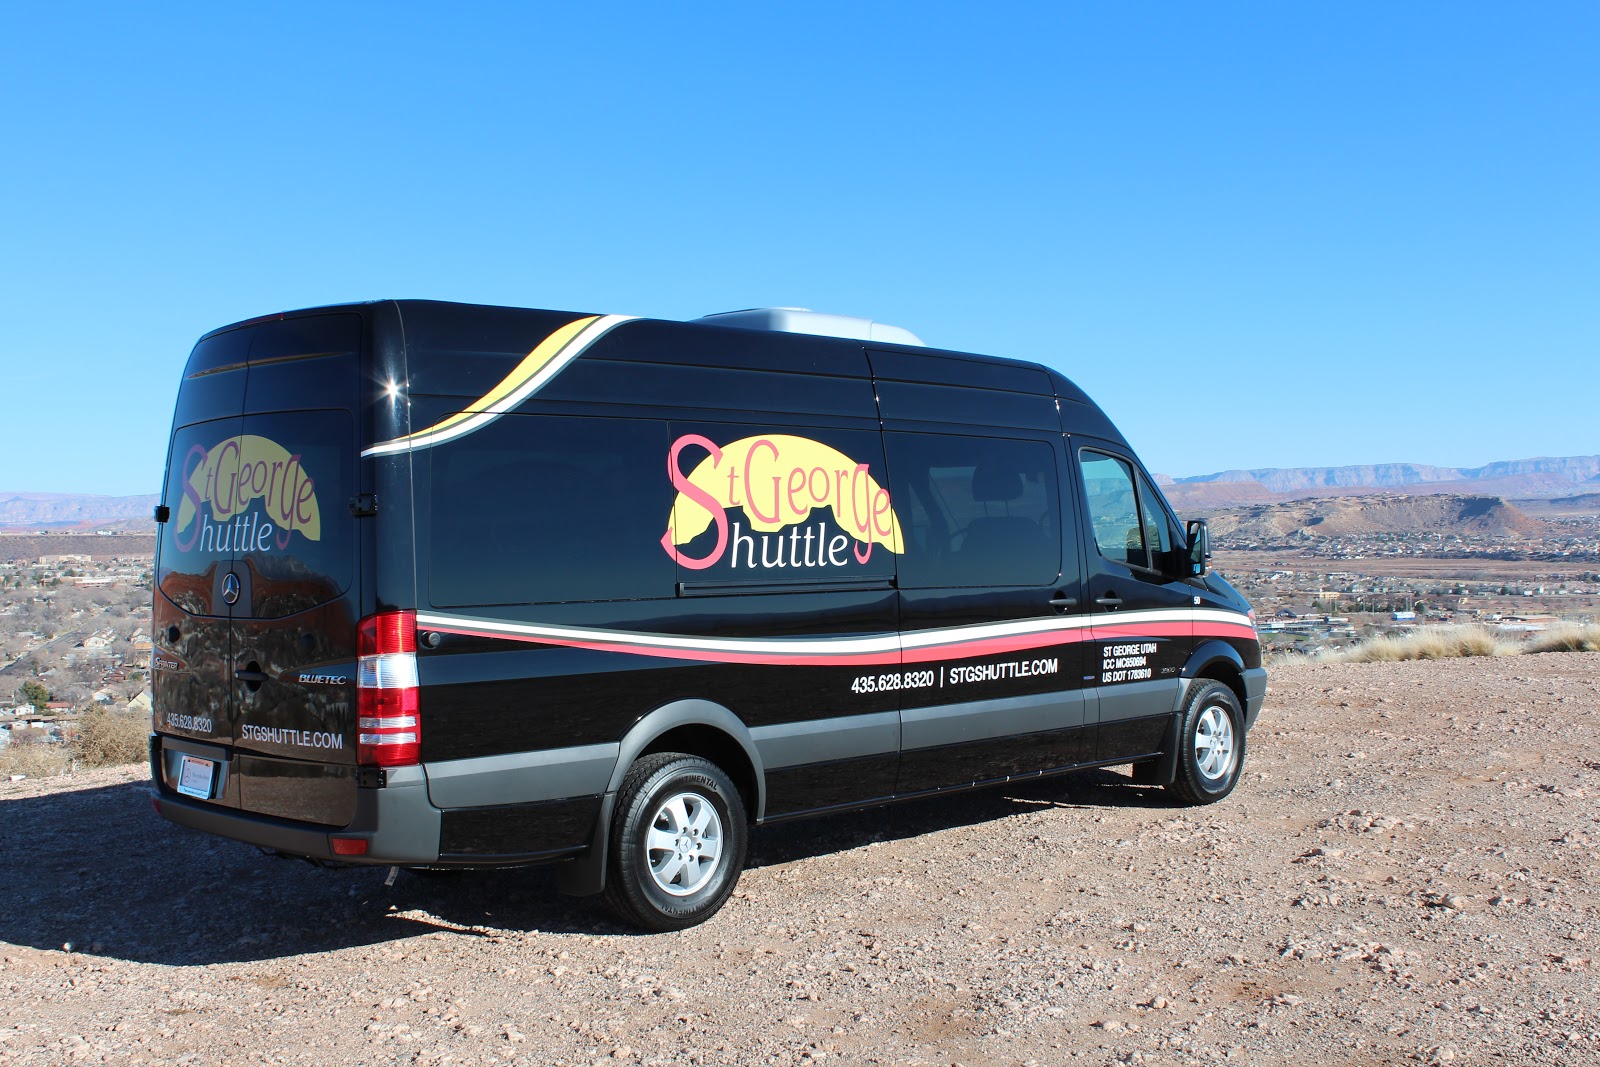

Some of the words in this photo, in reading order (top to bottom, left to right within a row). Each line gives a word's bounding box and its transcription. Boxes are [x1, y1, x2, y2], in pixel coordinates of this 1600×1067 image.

[1193, 595, 1201, 605] 50
[1103, 646, 1112, 657] ST
[1113, 644, 1140, 656] GEORGE
[1140, 642, 1157, 654] UTAH
[1102, 658, 1115, 670] ICC
[298, 673, 347, 685] BLUETEC
[851, 670, 934, 694] 435.628.8320
[949, 657, 1058, 684] STGSHUTTLE.COM
[1102, 671, 1113, 683] US
[1112, 669, 1127, 682] DOT
[166, 711, 212, 734] 435.628.8320
[241, 724, 343, 750] STGSHUTTLE.COM
